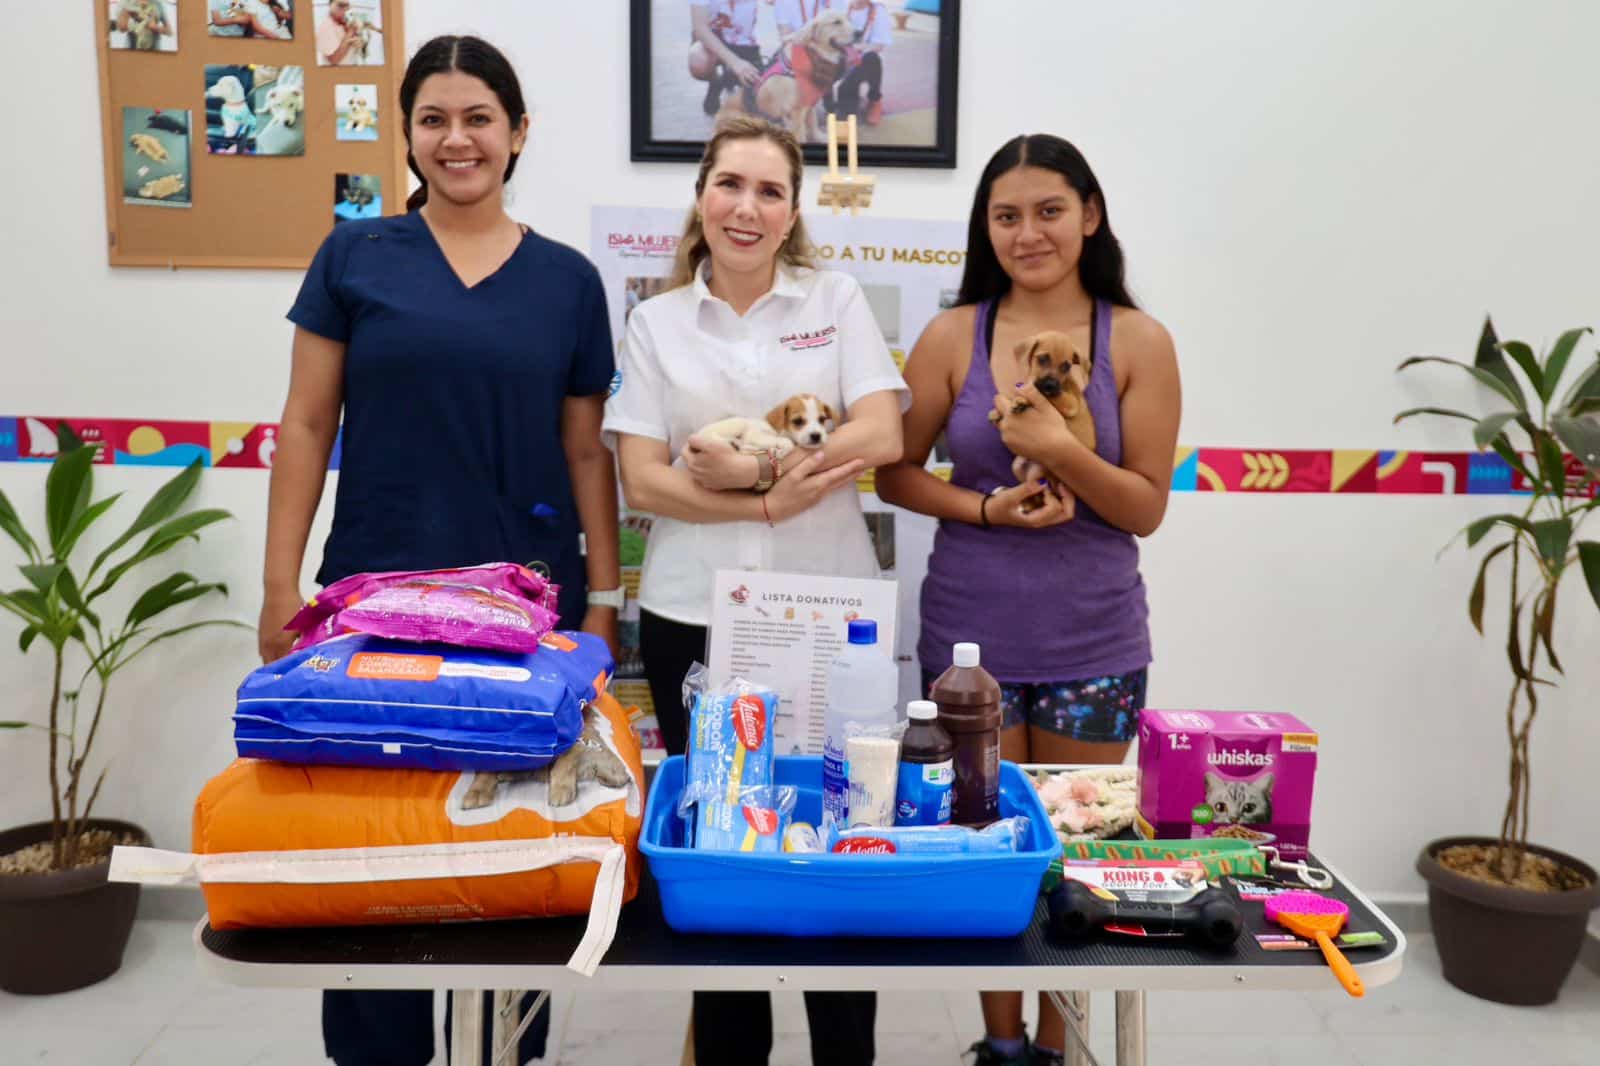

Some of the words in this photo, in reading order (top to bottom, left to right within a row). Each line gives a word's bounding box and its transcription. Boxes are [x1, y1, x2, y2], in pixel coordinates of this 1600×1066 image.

[840, 245, 855, 261] A
[860, 245, 885, 261] TU
[762, 593, 793, 602] LISTA
[797, 595, 862, 607] DONATIVOS
[1207, 748, 1273, 766] whiskas
[1103, 871, 1150, 883] KONG
